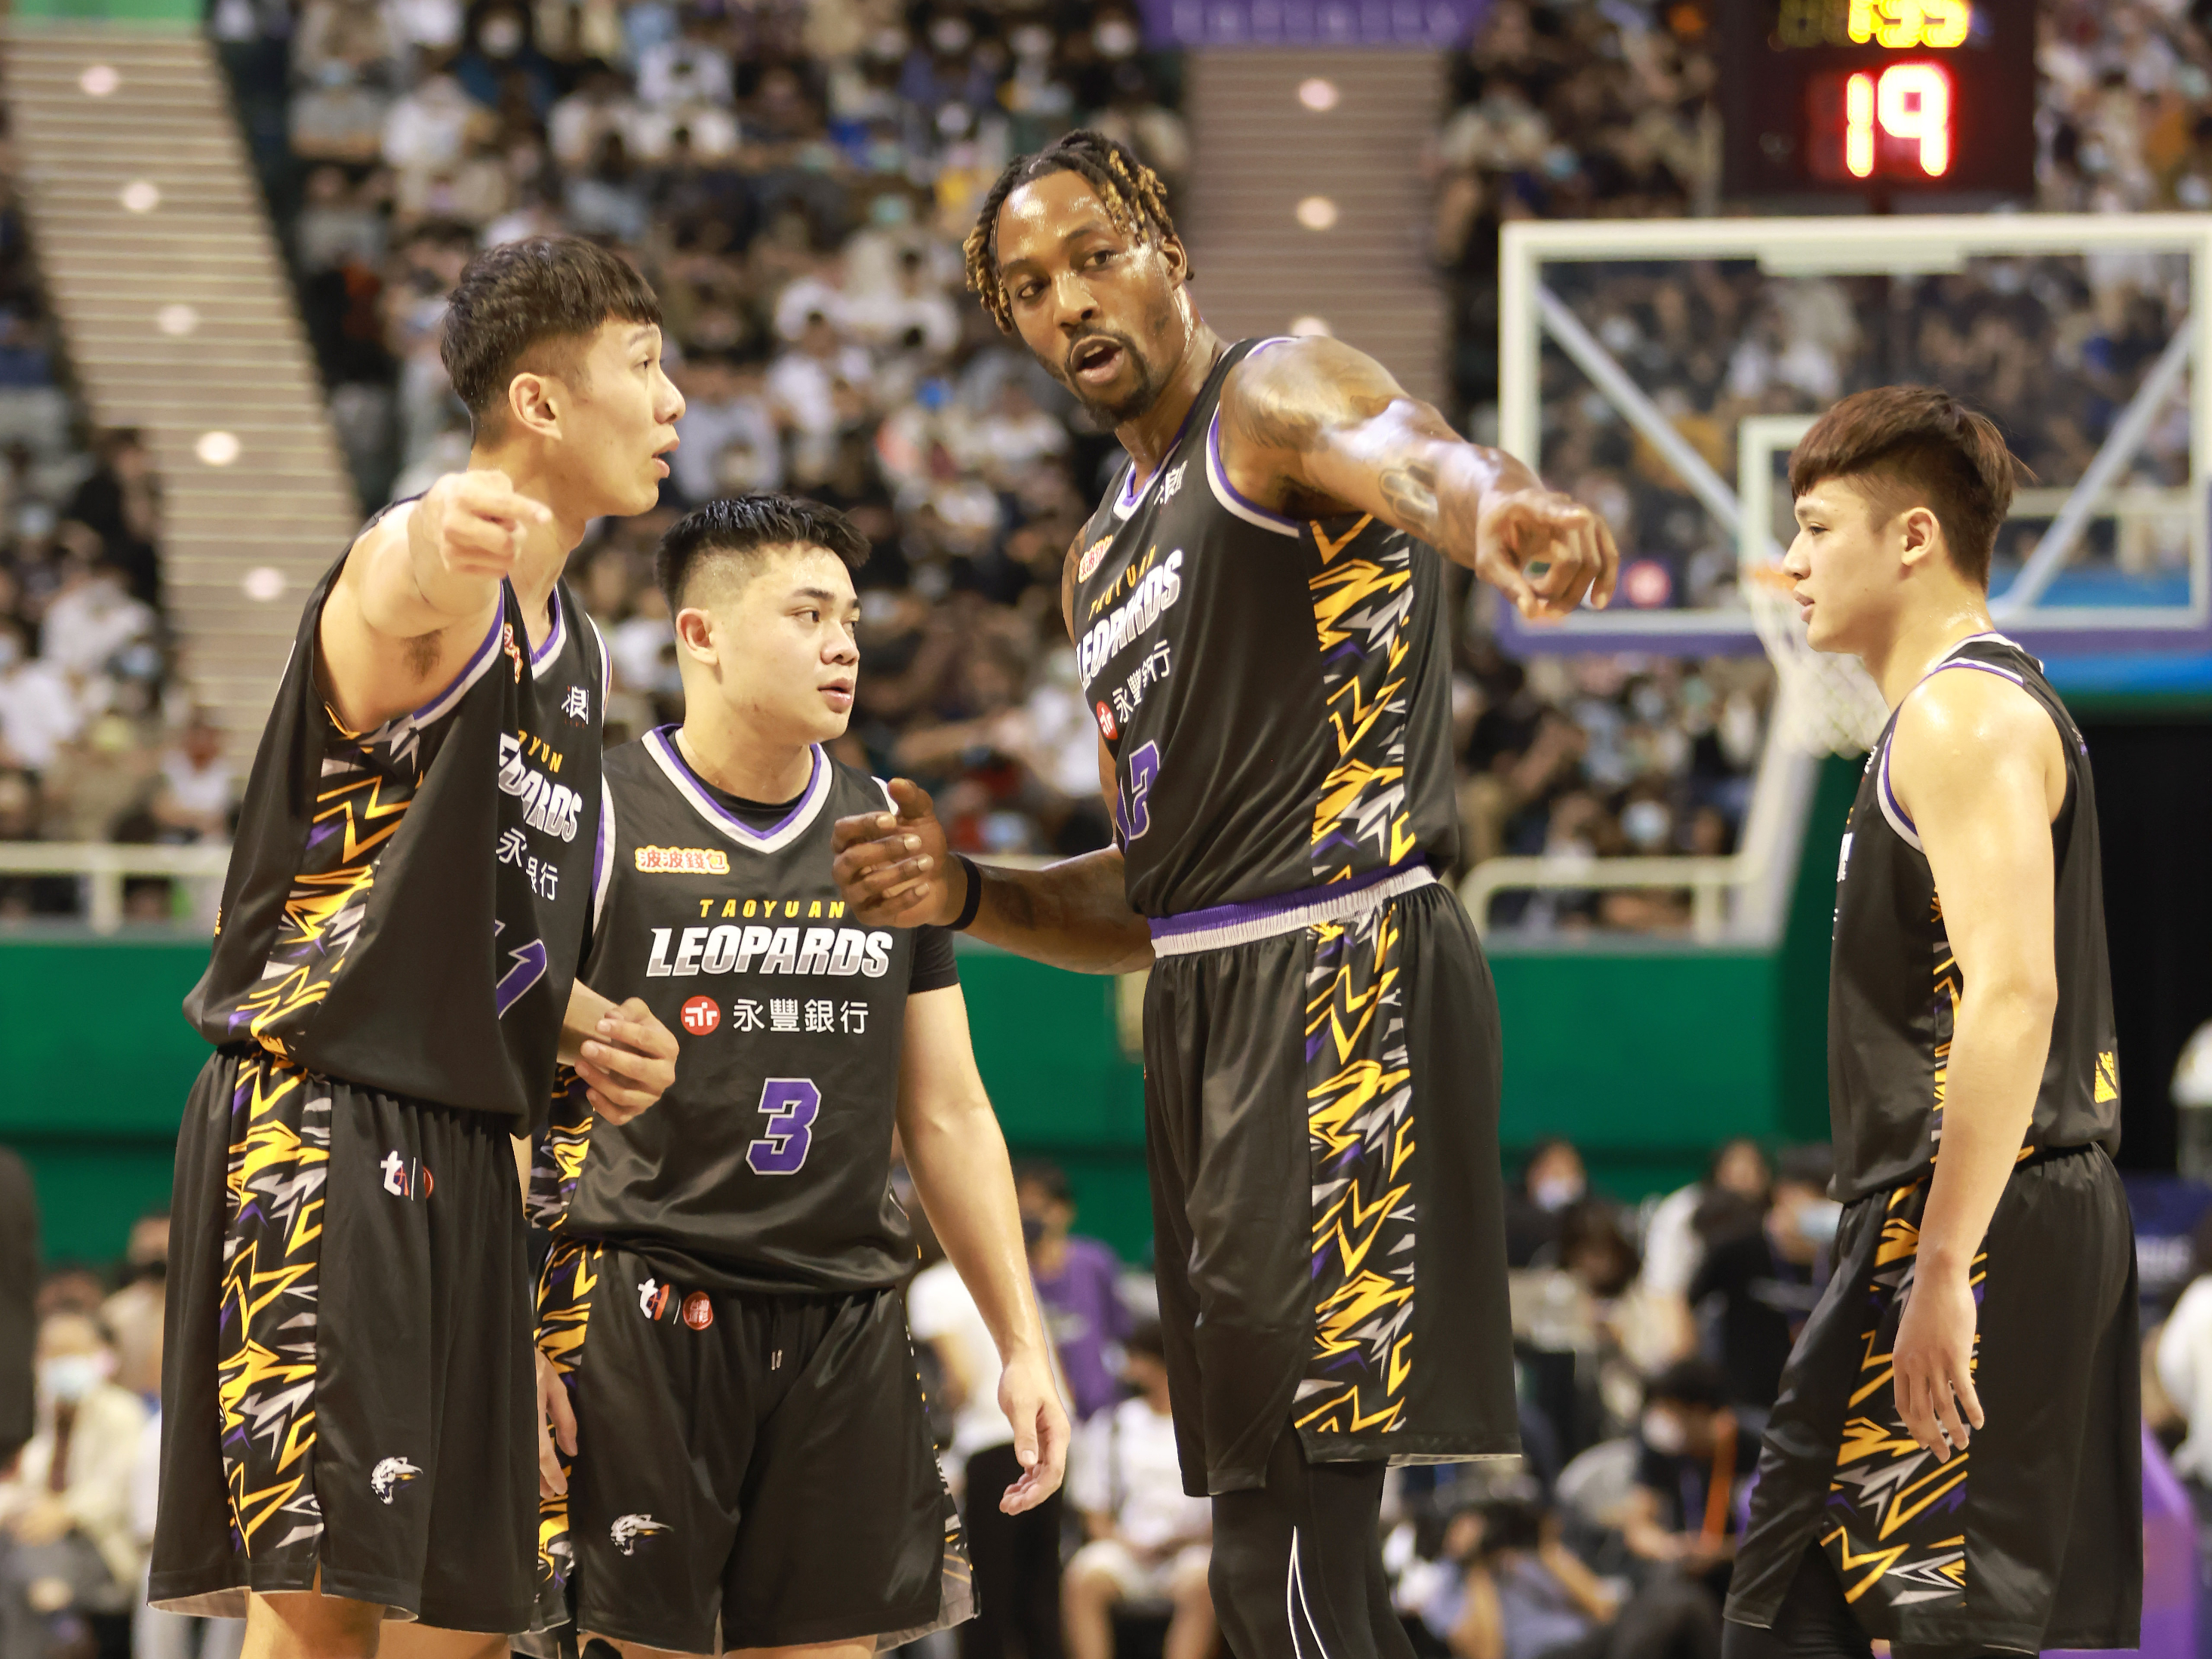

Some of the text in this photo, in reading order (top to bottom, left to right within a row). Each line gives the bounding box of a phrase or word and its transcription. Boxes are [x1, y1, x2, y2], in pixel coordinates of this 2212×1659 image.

[1847, 65, 1949, 177] 19
[638, 848, 728, 871] 波波錢包
[699, 899, 846, 919] TAOYUAN
[646, 925, 894, 977] LEOPARDS
[732, 998, 869, 1034] 永豐銀行
[746, 1077, 822, 1175] 3
